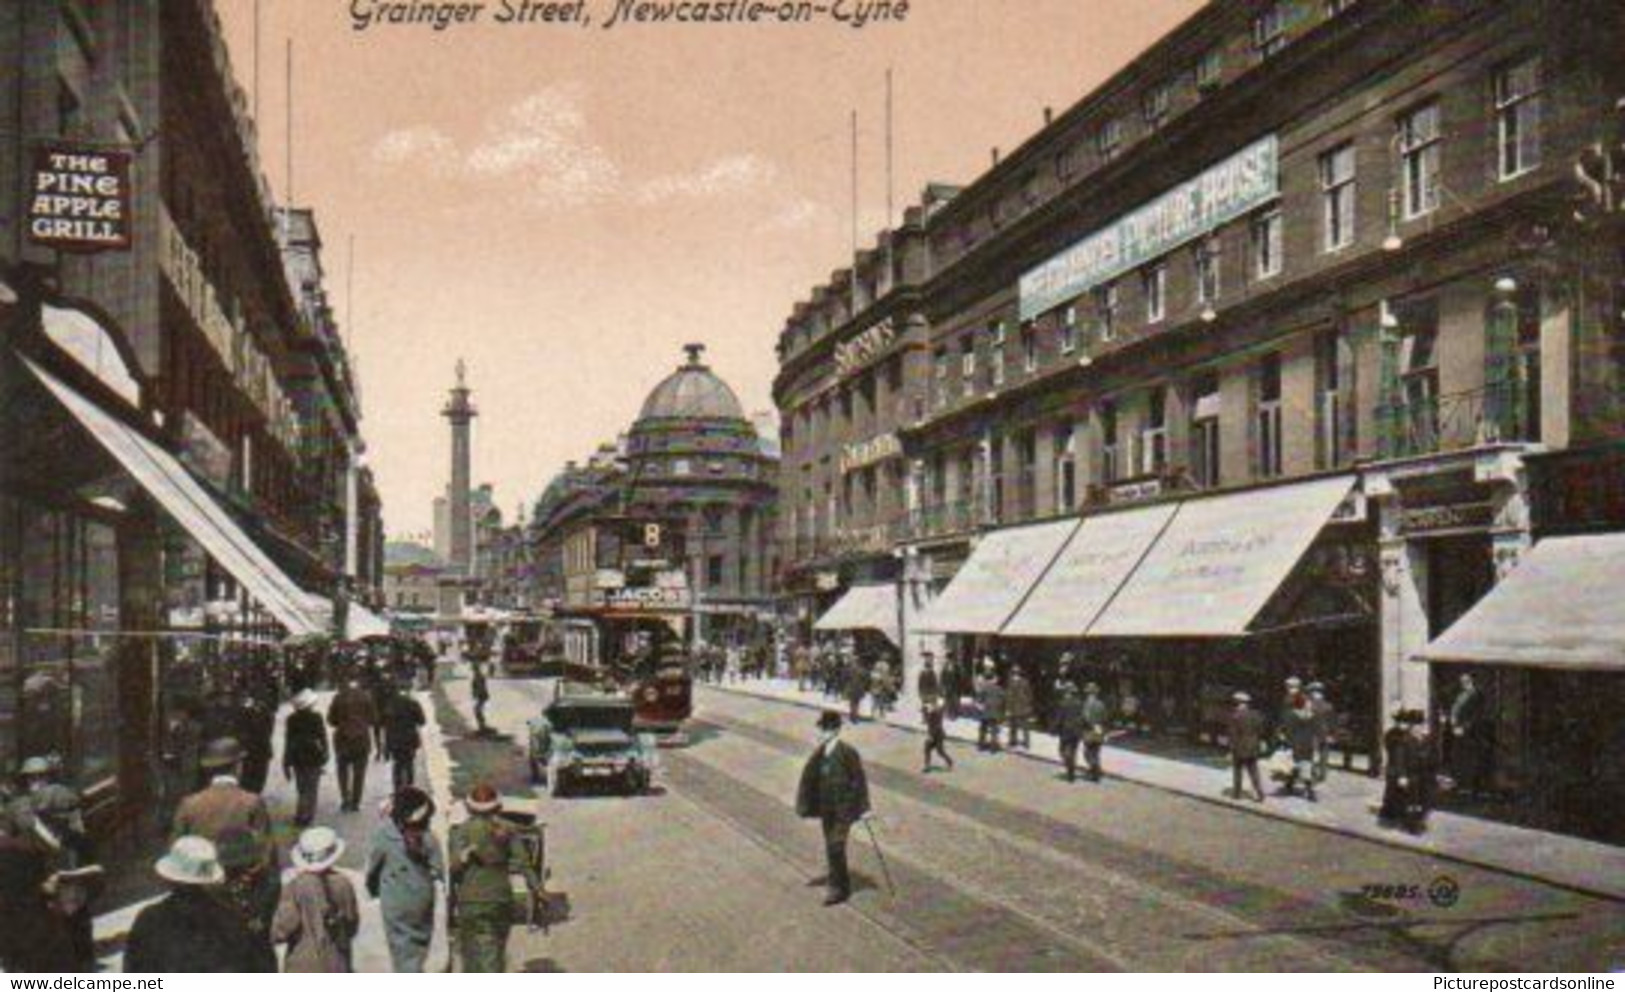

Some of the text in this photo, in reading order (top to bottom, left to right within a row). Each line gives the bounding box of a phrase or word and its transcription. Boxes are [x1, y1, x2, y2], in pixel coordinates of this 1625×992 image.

[50, 154, 108, 172] THE
[37, 172, 119, 195] PINE
[32, 194, 121, 219] APPLE
[32, 218, 123, 240] GRILL
